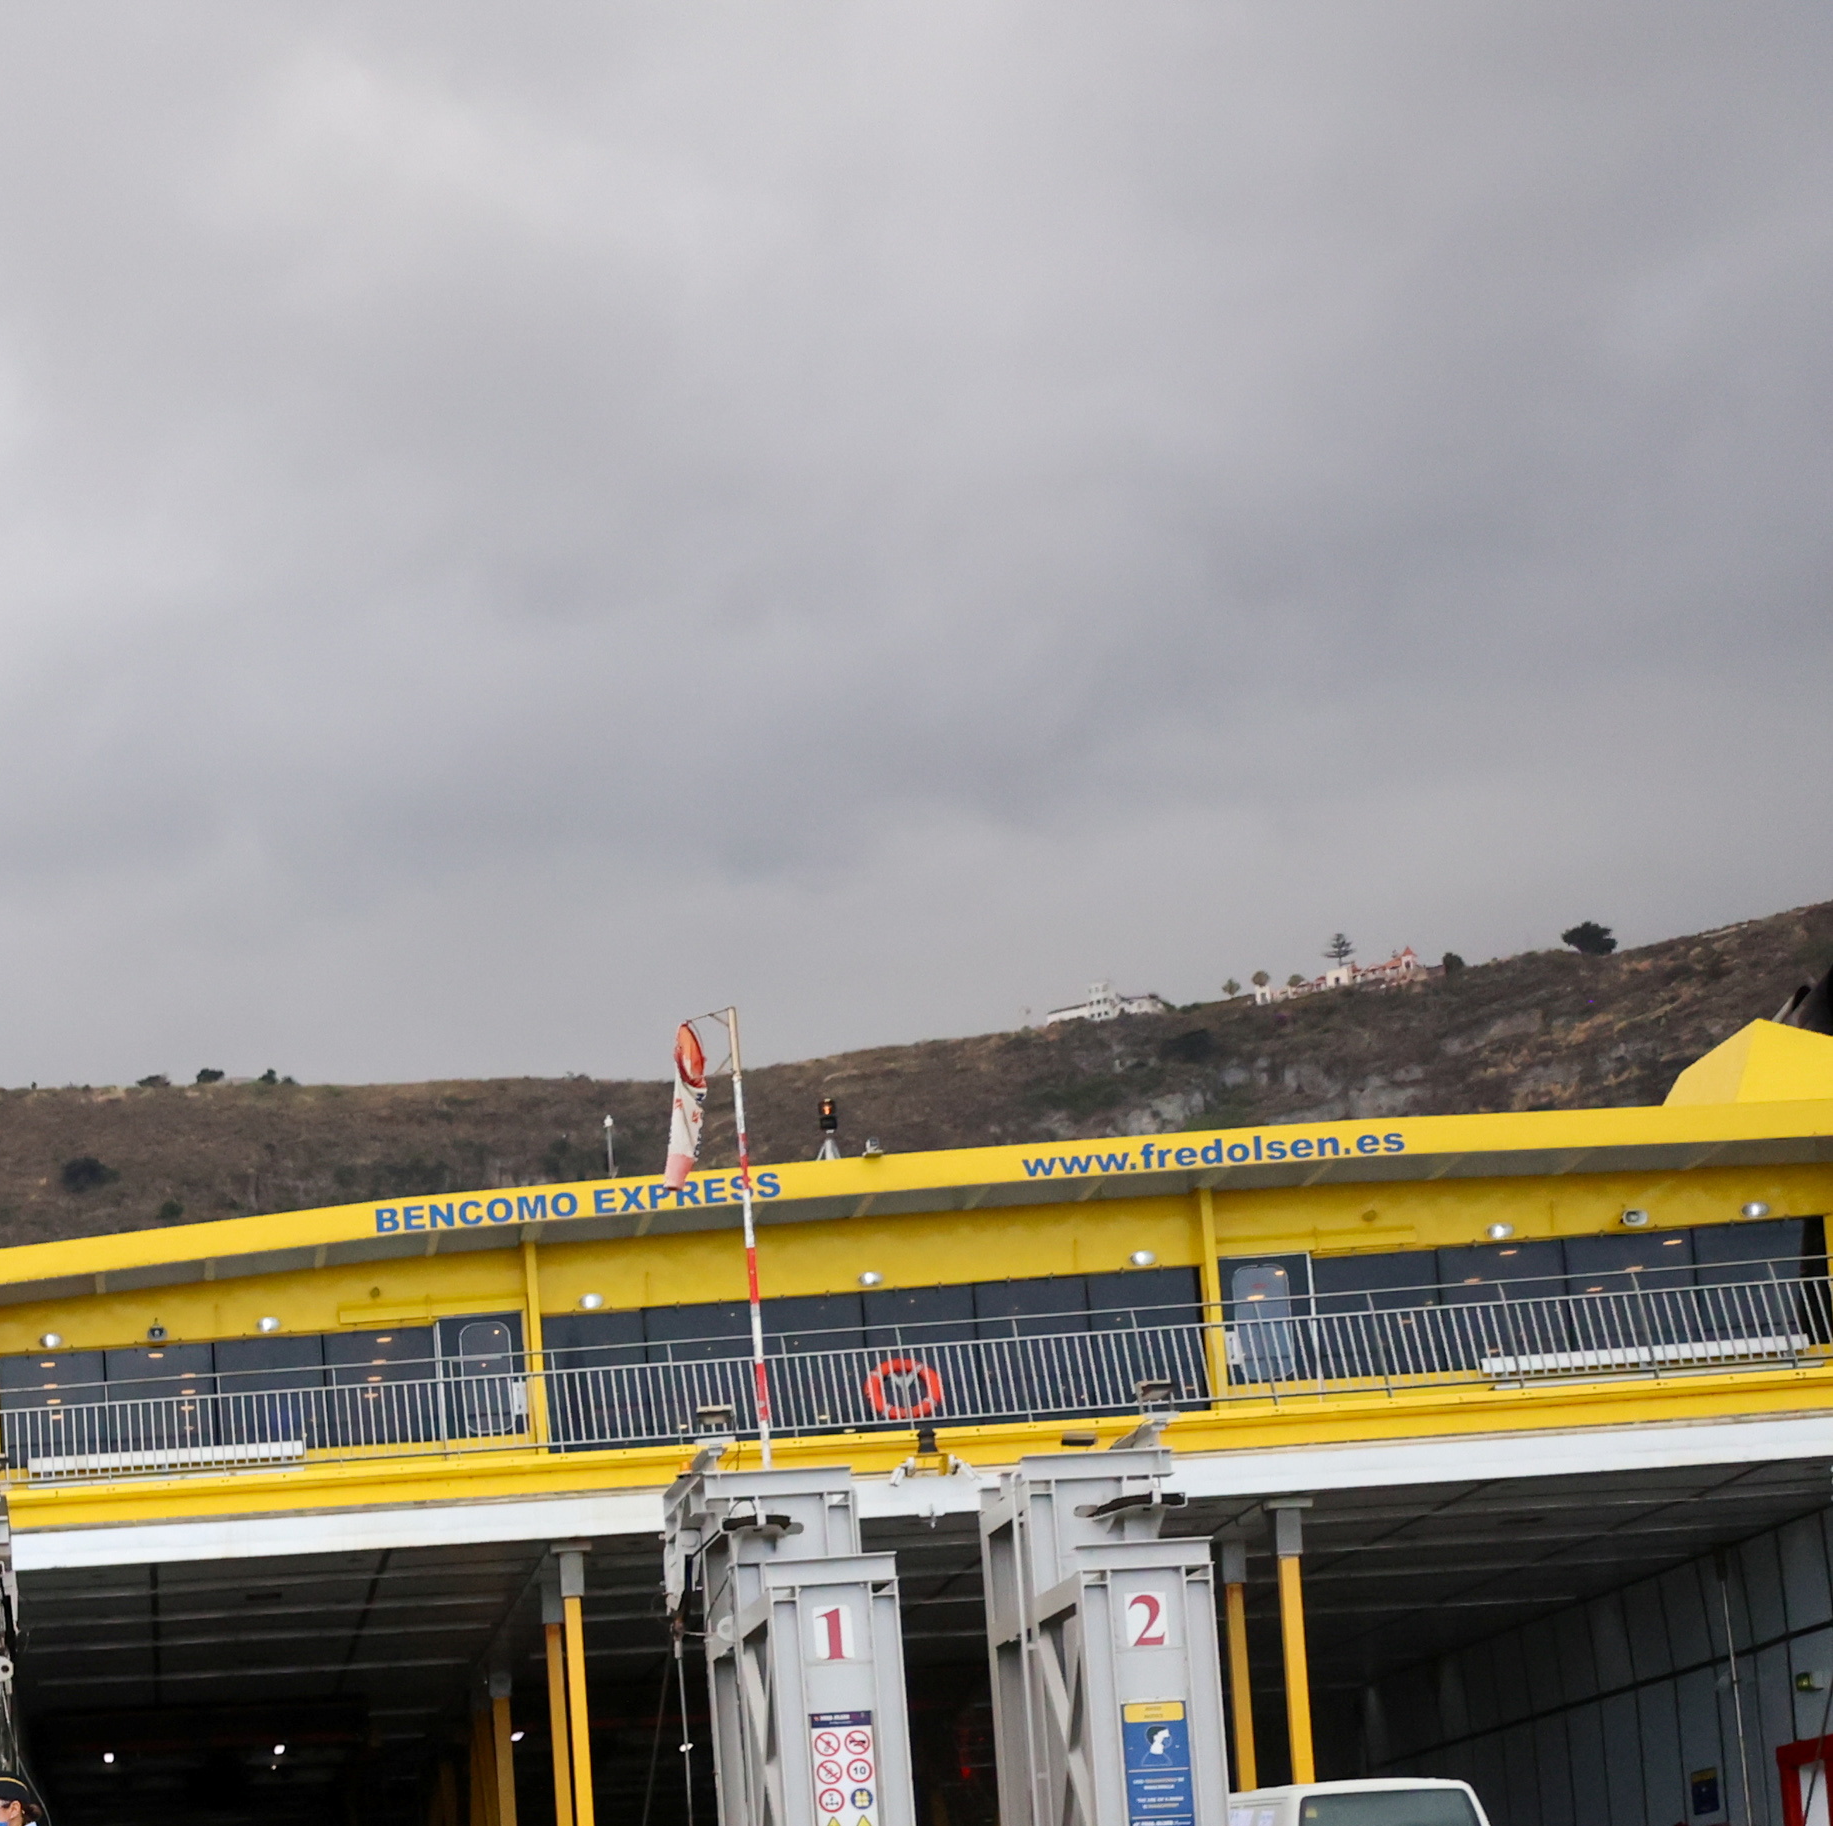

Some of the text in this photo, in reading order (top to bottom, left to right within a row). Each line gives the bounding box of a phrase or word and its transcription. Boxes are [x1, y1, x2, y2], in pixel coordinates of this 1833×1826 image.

[1022, 1131, 1406, 1177] www.fredolsen.es
[375, 1172, 781, 1233] BENCOMO EXPRESS
[814, 1607, 847, 1660] 1
[1128, 1594, 1167, 1647] 2
[852, 1765, 867, 1776] 10
